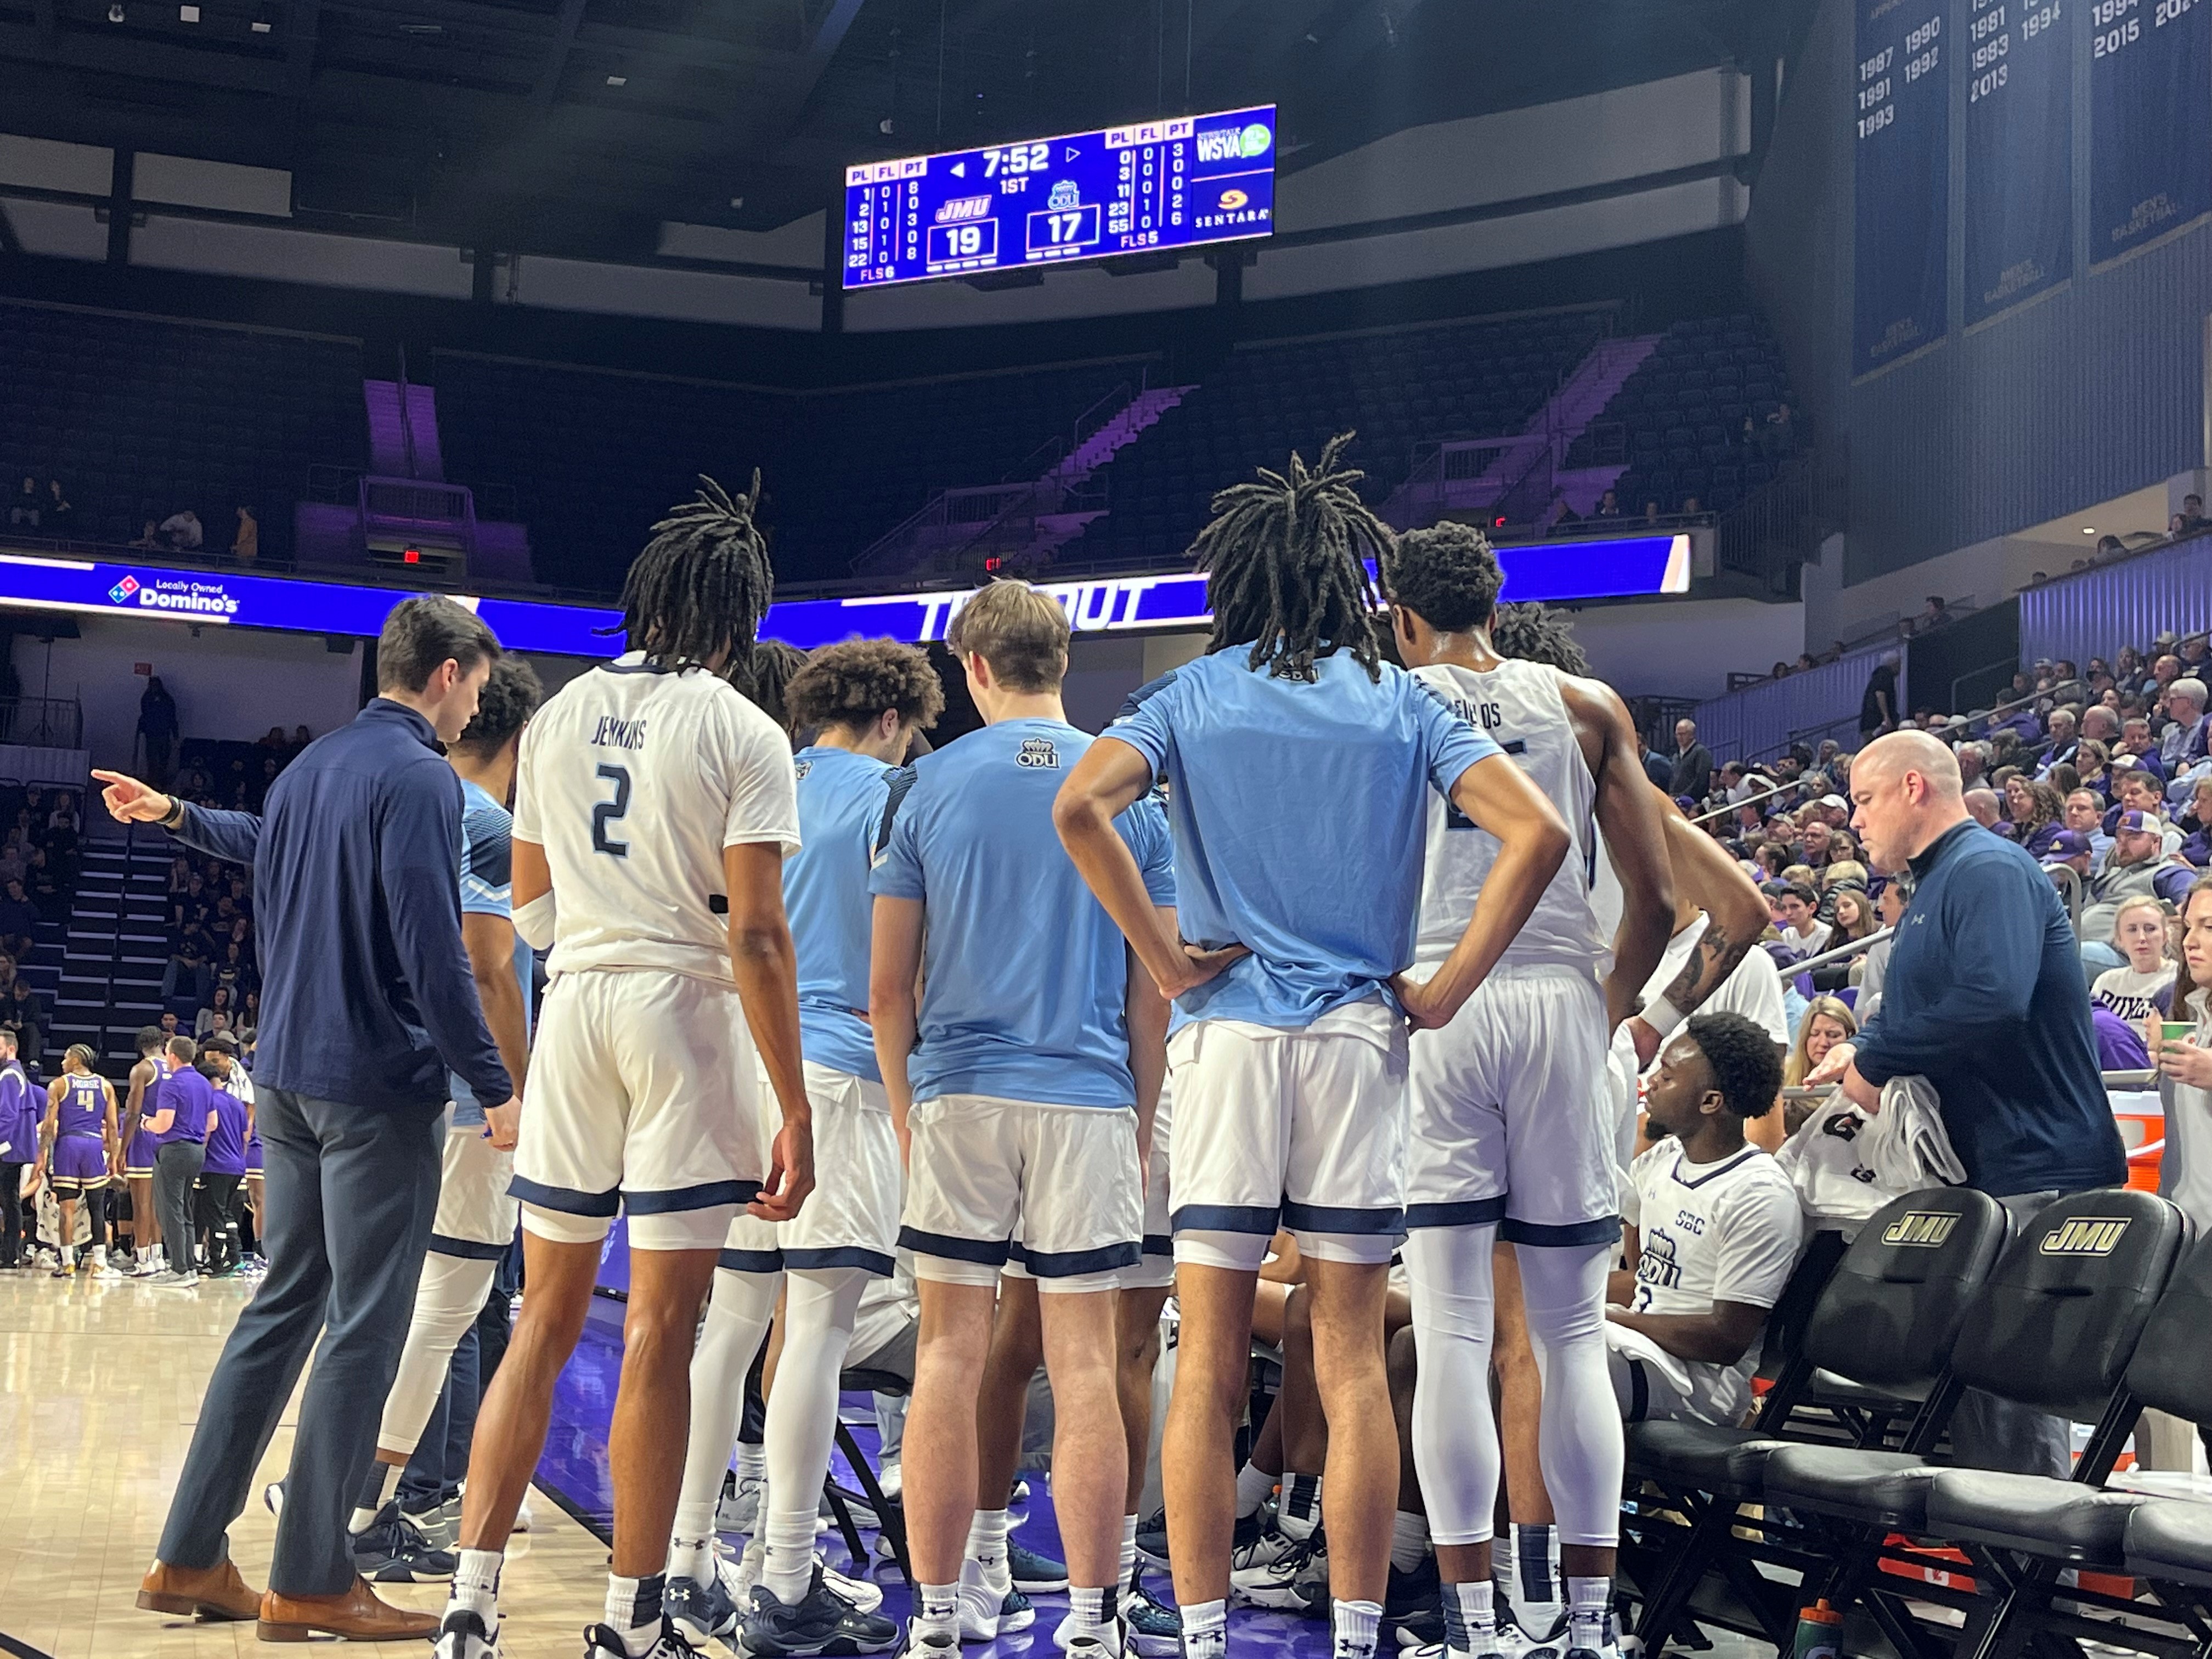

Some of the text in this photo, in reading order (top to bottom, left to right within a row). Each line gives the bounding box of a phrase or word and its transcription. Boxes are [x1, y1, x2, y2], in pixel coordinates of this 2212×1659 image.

[1970, 5, 2005, 42] 1981
[1972, 1, 2061, 71] 1983 1994
[2094, 18, 2139, 58] 2015
[1859, 16, 1940, 82] 1987 1990
[1858, 46, 1939, 110] 1991 1992
[1971, 63, 2007, 103] 2013
[1858, 104, 1894, 138] 1993
[1111, 122, 1188, 144] PL FL PT
[1120, 143, 1183, 164] 0 0 3
[1196, 135, 1242, 162] WSVA
[852, 161, 922, 182] PL FL PT
[983, 144, 1049, 178] 7:52
[1119, 159, 1184, 180] 3 0 0
[864, 181, 918, 200] 1 0 8
[1000, 177, 1029, 194] 1ST
[1117, 176, 1183, 198] 11 0 0
[859, 196, 919, 217] 2 1 0
[936, 196, 990, 222] JMU
[1108, 194, 1183, 217] 23 1 2
[853, 213, 917, 234] 13 0 3
[1108, 211, 1182, 234] 55 0 6
[1195, 208, 1267, 228] SENTARA
[852, 229, 917, 251] 15 1 0
[946, 213, 1082, 256] 19 17
[1121, 230, 1158, 248] FLS 5
[849, 246, 917, 267] 22 0 8
[860, 265, 895, 281] FLS 6
[156, 579, 223, 593] Locally Owned
[140, 588, 238, 613] Domino's
[591, 716, 647, 750] JENKINS
[1017, 752, 1059, 768] ODU
[592, 761, 631, 859] 2
[77, 1090, 94, 1112] 4
[1675, 1210, 1705, 1235] SBC
[1883, 1213, 2129, 1254] JMU JMU
